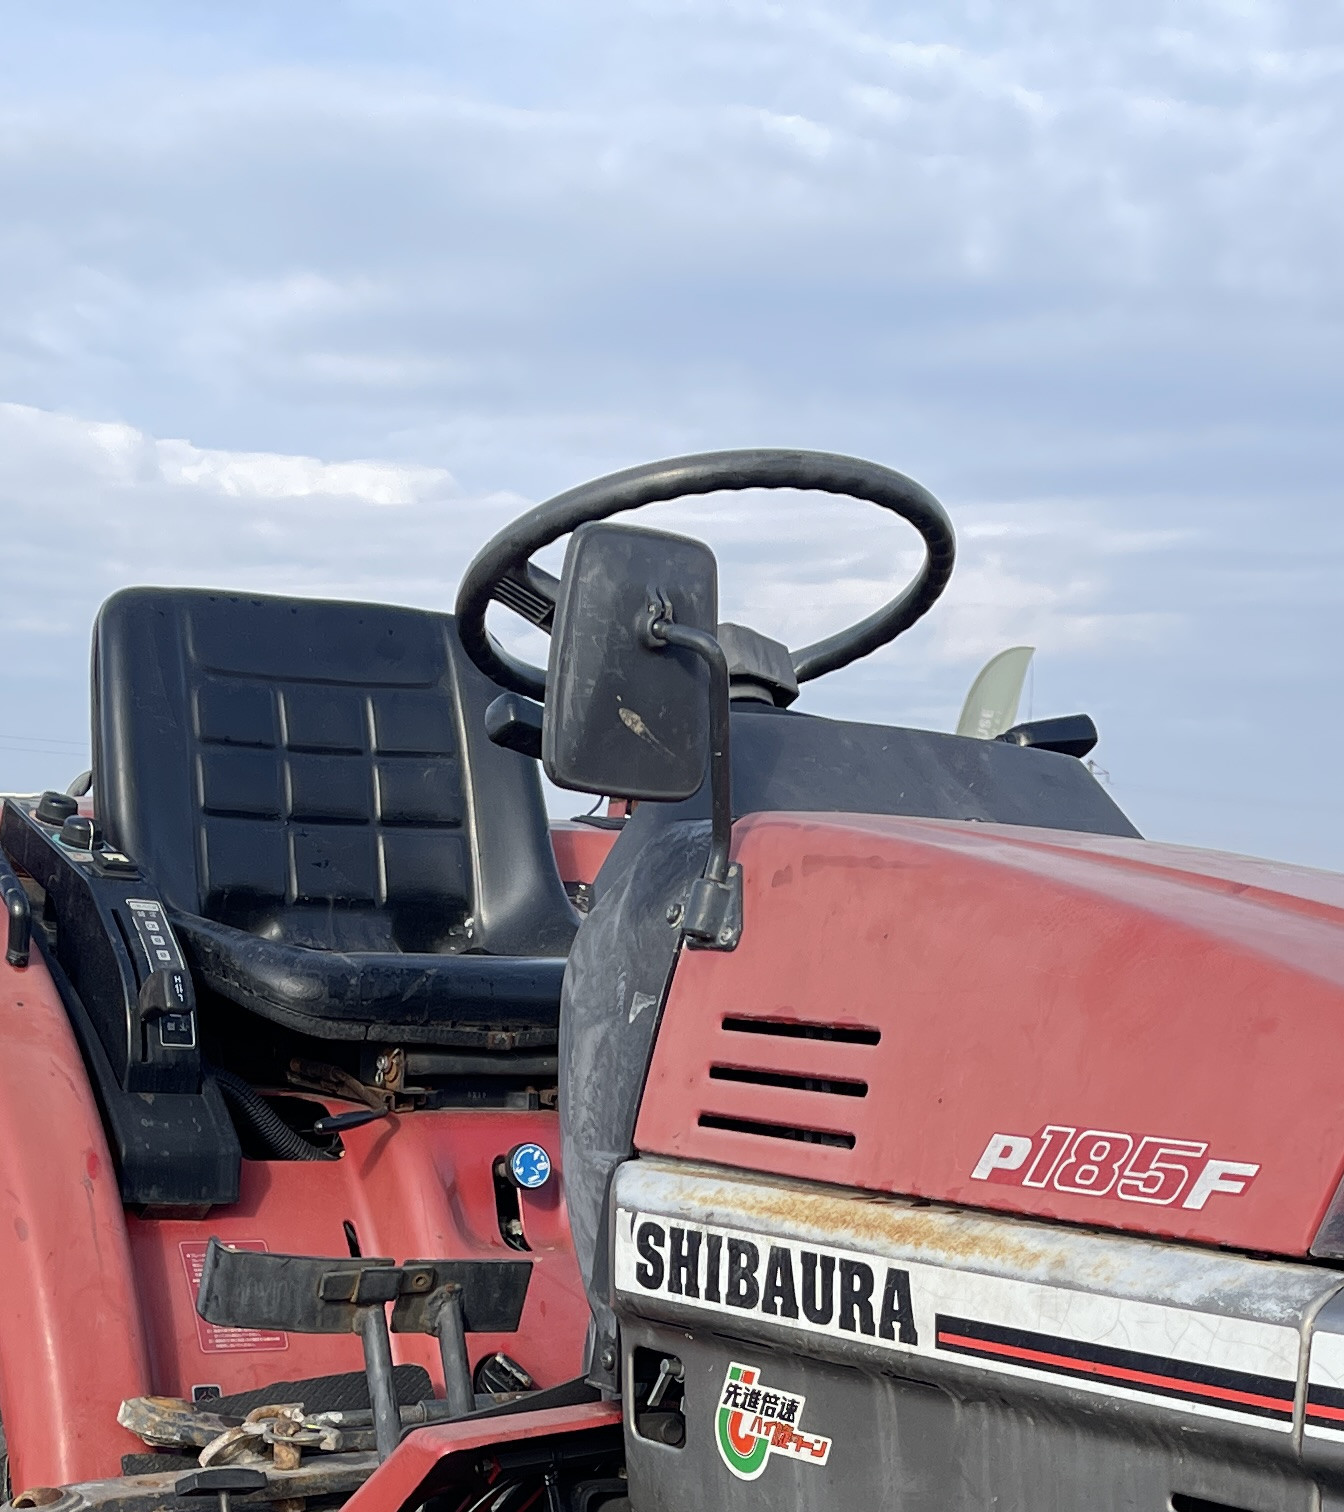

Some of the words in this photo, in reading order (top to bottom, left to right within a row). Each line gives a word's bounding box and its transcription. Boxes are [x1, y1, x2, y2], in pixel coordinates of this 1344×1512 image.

[970, 1125, 1260, 1210] P185F
[636, 1221, 918, 1346] SHIBAURA
[722, 1382, 800, 1423] 先進倍速
